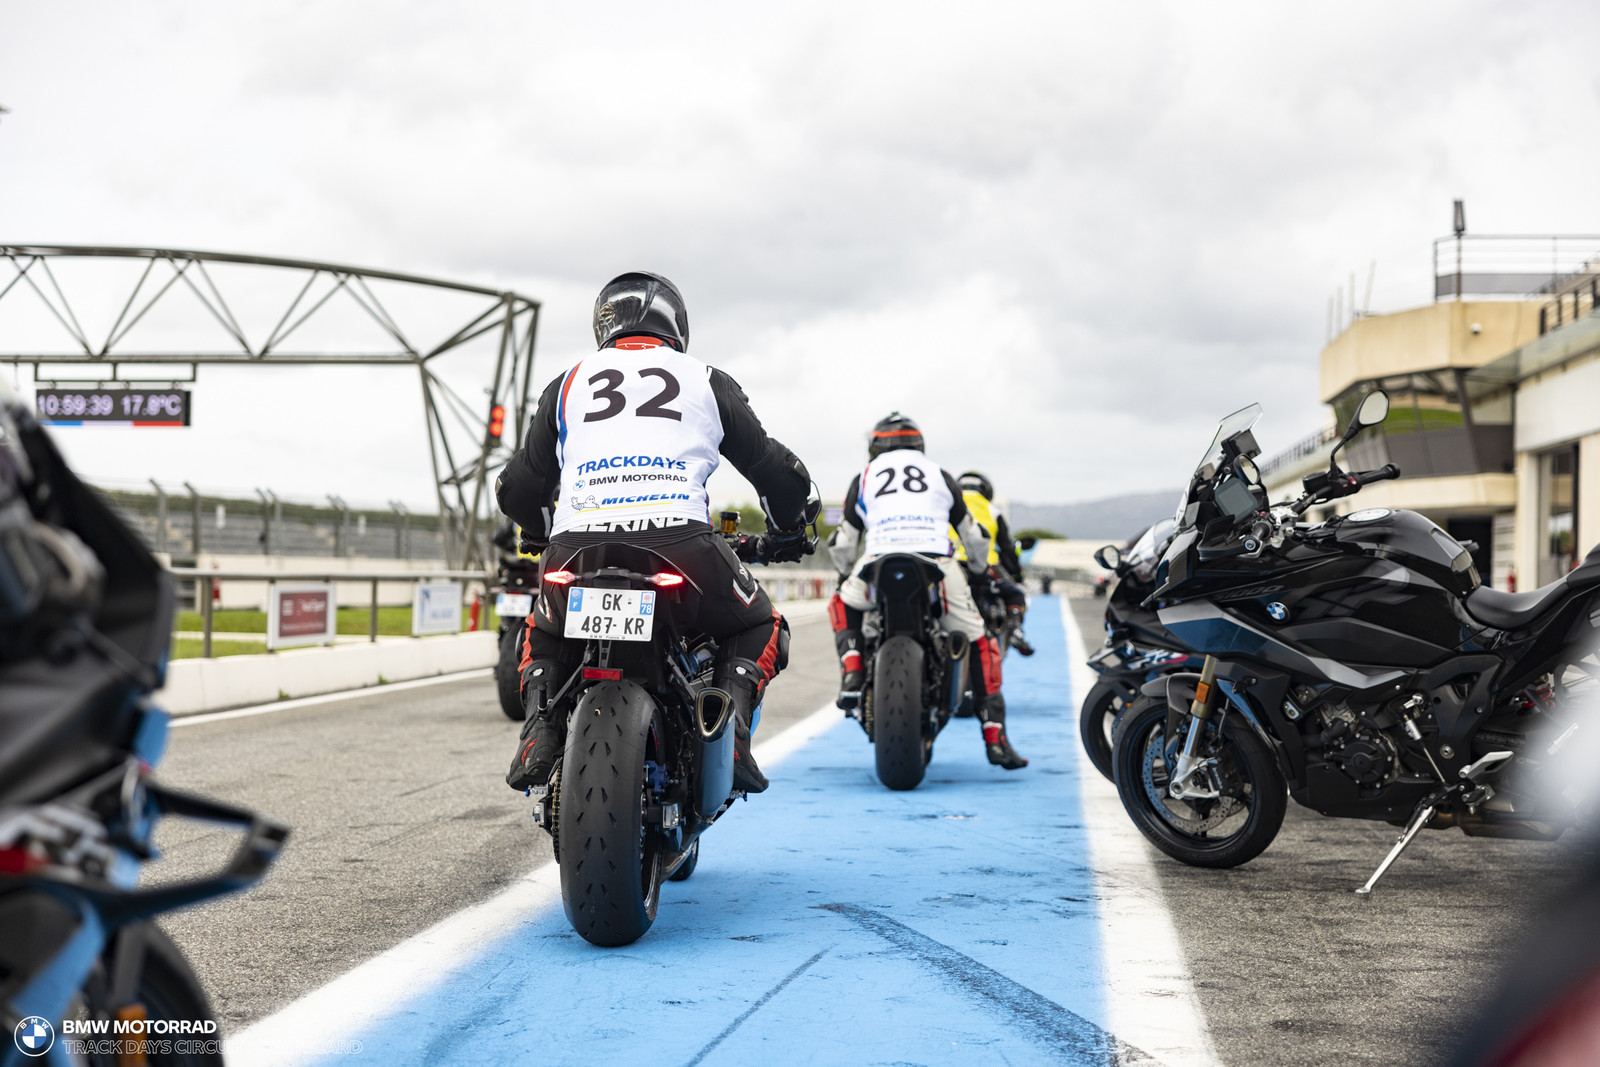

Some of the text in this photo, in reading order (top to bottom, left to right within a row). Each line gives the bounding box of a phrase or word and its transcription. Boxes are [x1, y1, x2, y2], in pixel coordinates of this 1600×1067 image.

[583, 367, 682, 423] 32
[576, 455, 687, 476] TRACKDAYS
[589, 474, 688, 486] BMW MOTORRAD
[875, 465, 928, 499] 28
[601, 493, 690, 506] MICHELIN
[641, 604, 652, 614] 78
[624, 617, 645, 635] KR
